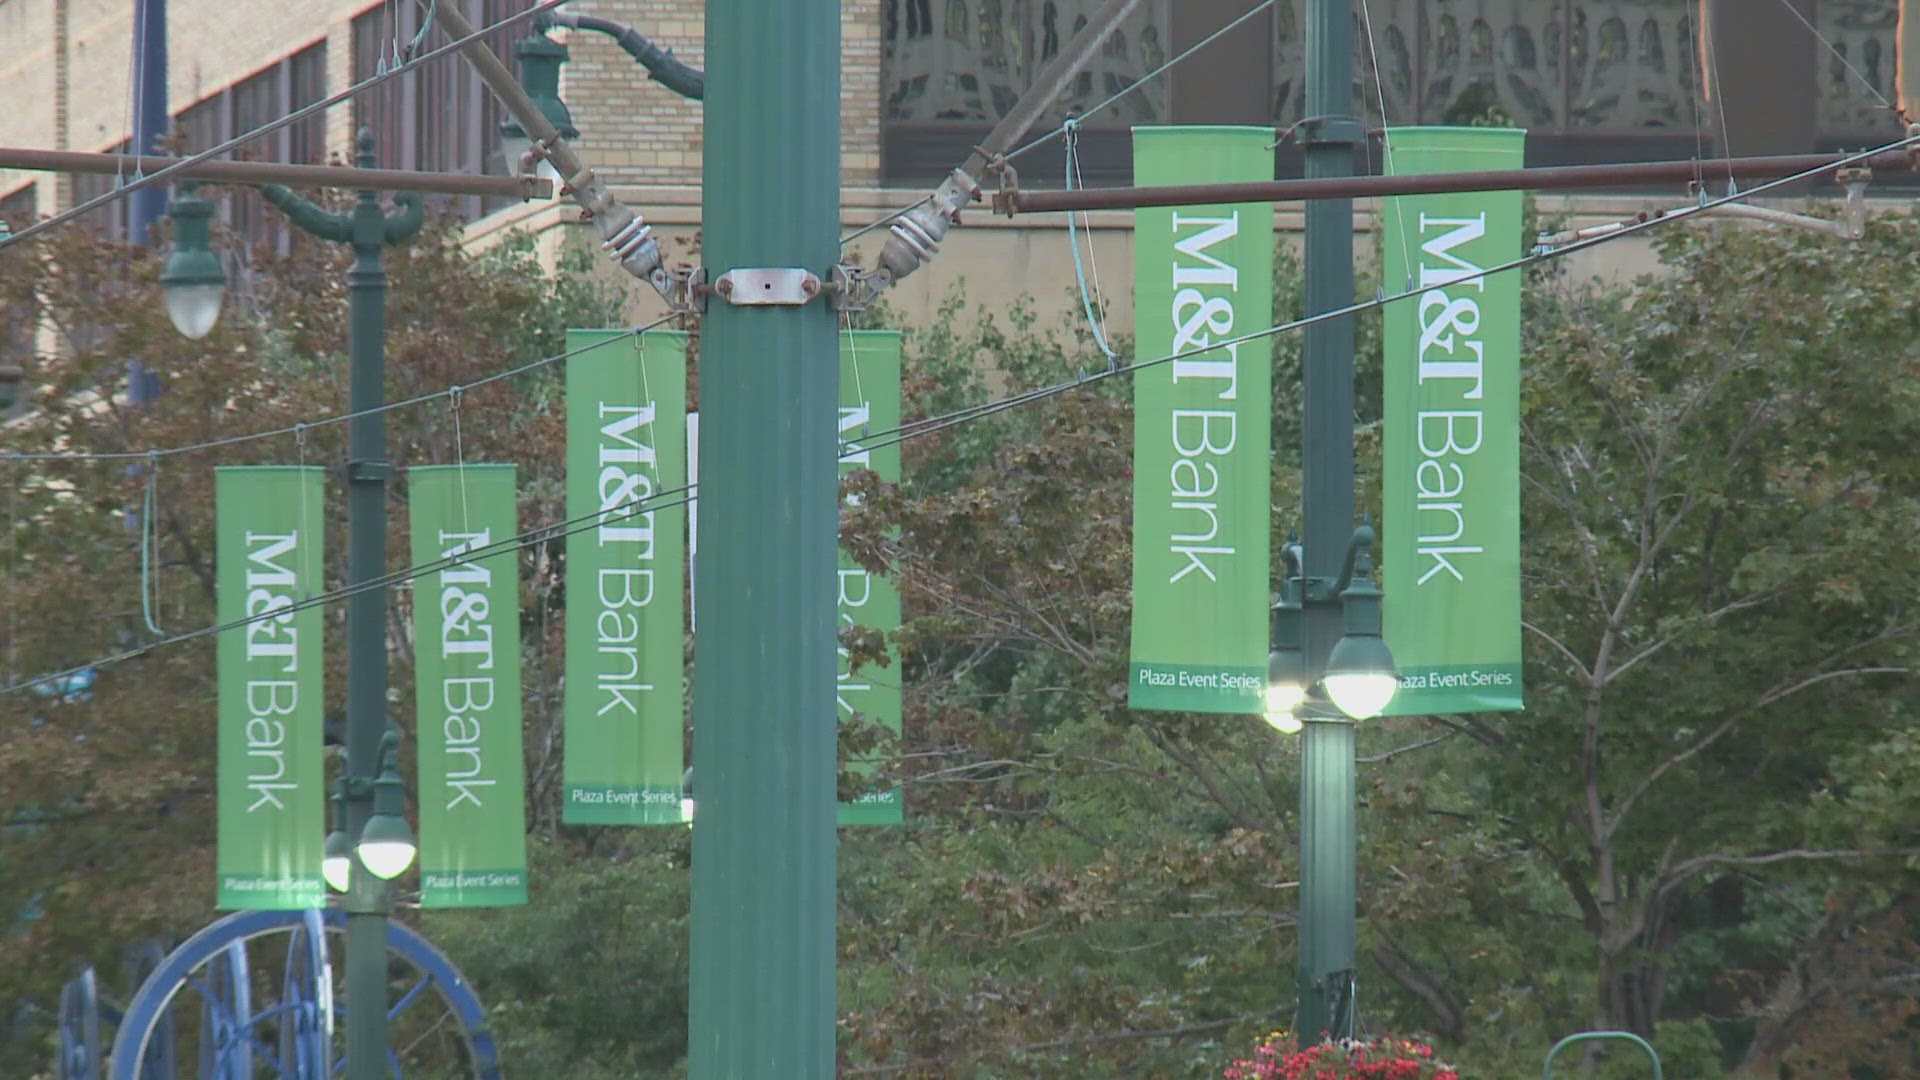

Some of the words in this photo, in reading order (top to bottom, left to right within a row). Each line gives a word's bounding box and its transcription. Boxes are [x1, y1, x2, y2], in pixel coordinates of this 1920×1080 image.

[1172, 210, 1238, 400] M&T
[1418, 211, 1486, 400] M&T
[598, 401, 656, 560] M&T
[1170, 409, 1237, 584] Bank
[1416, 410, 1484, 586] Bank
[245, 530, 298, 673] M&T
[438, 527, 494, 669] M&T
[597, 567, 655, 716] Bank
[245, 680, 299, 813] Bank
[442, 677, 497, 810] Bank
[1139, 668, 1176, 686] Plaza
[1178, 671, 1218, 687] Event
[1220, 672, 1261, 689] Series
[1429, 672, 1469, 688] Event
[1470, 670, 1513, 686] Series
[572, 788, 604, 803] Plaza
[606, 789, 639, 803] Event
[641, 790, 677, 803] Series
